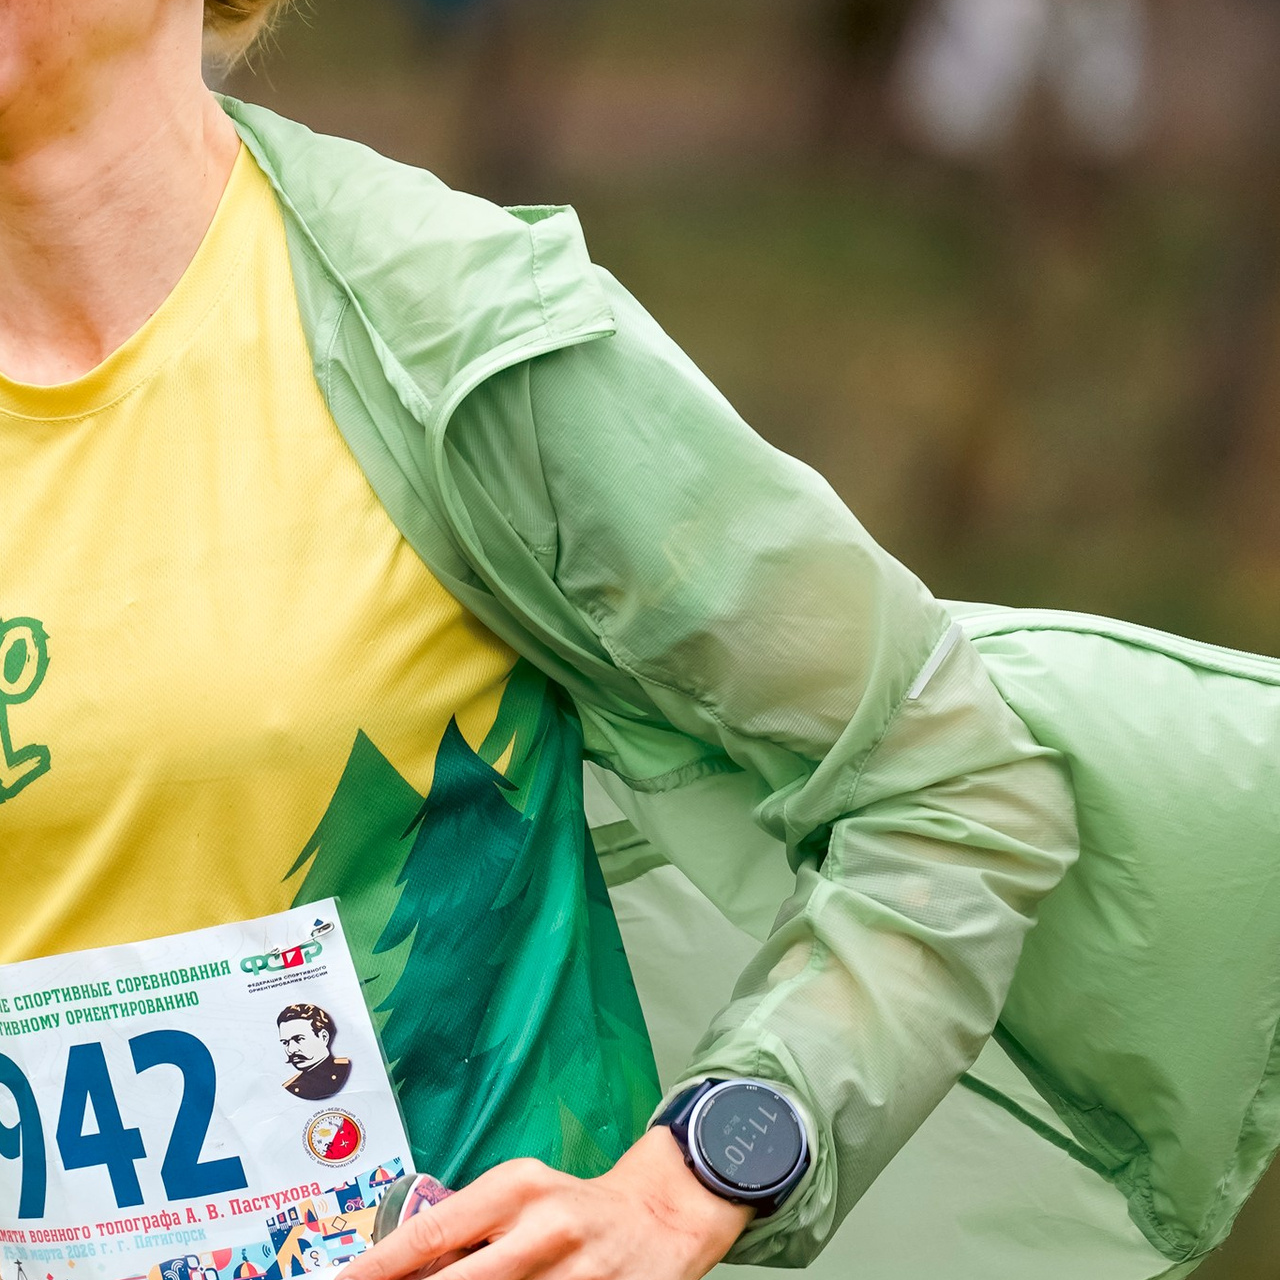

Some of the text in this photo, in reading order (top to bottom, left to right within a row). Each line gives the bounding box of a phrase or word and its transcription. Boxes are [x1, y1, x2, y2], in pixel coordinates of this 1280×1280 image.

[13, 979, 112, 1011] СПОРТИВНЫЕ
[116, 960, 232, 995] СОРЕВНОВАНИЯ
[66, 990, 200, 1026] ОРИЕНТИРОВАНИЮ
[725, 1106, 777, 1164] 11:10
[30, 1225, 91, 1244] военного
[96, 1209, 182, 1237] топографа
[186, 1207, 201, 1224] А.
[208, 1203, 224, 1220] В.
[229, 1181, 321, 1216] Пастухова
[64, 1243, 97, 1260] 2026
[101, 1242, 114, 1255] г.
[118, 1239, 131, 1252] г.
[134, 1228, 208, 1249] Пятигорск
